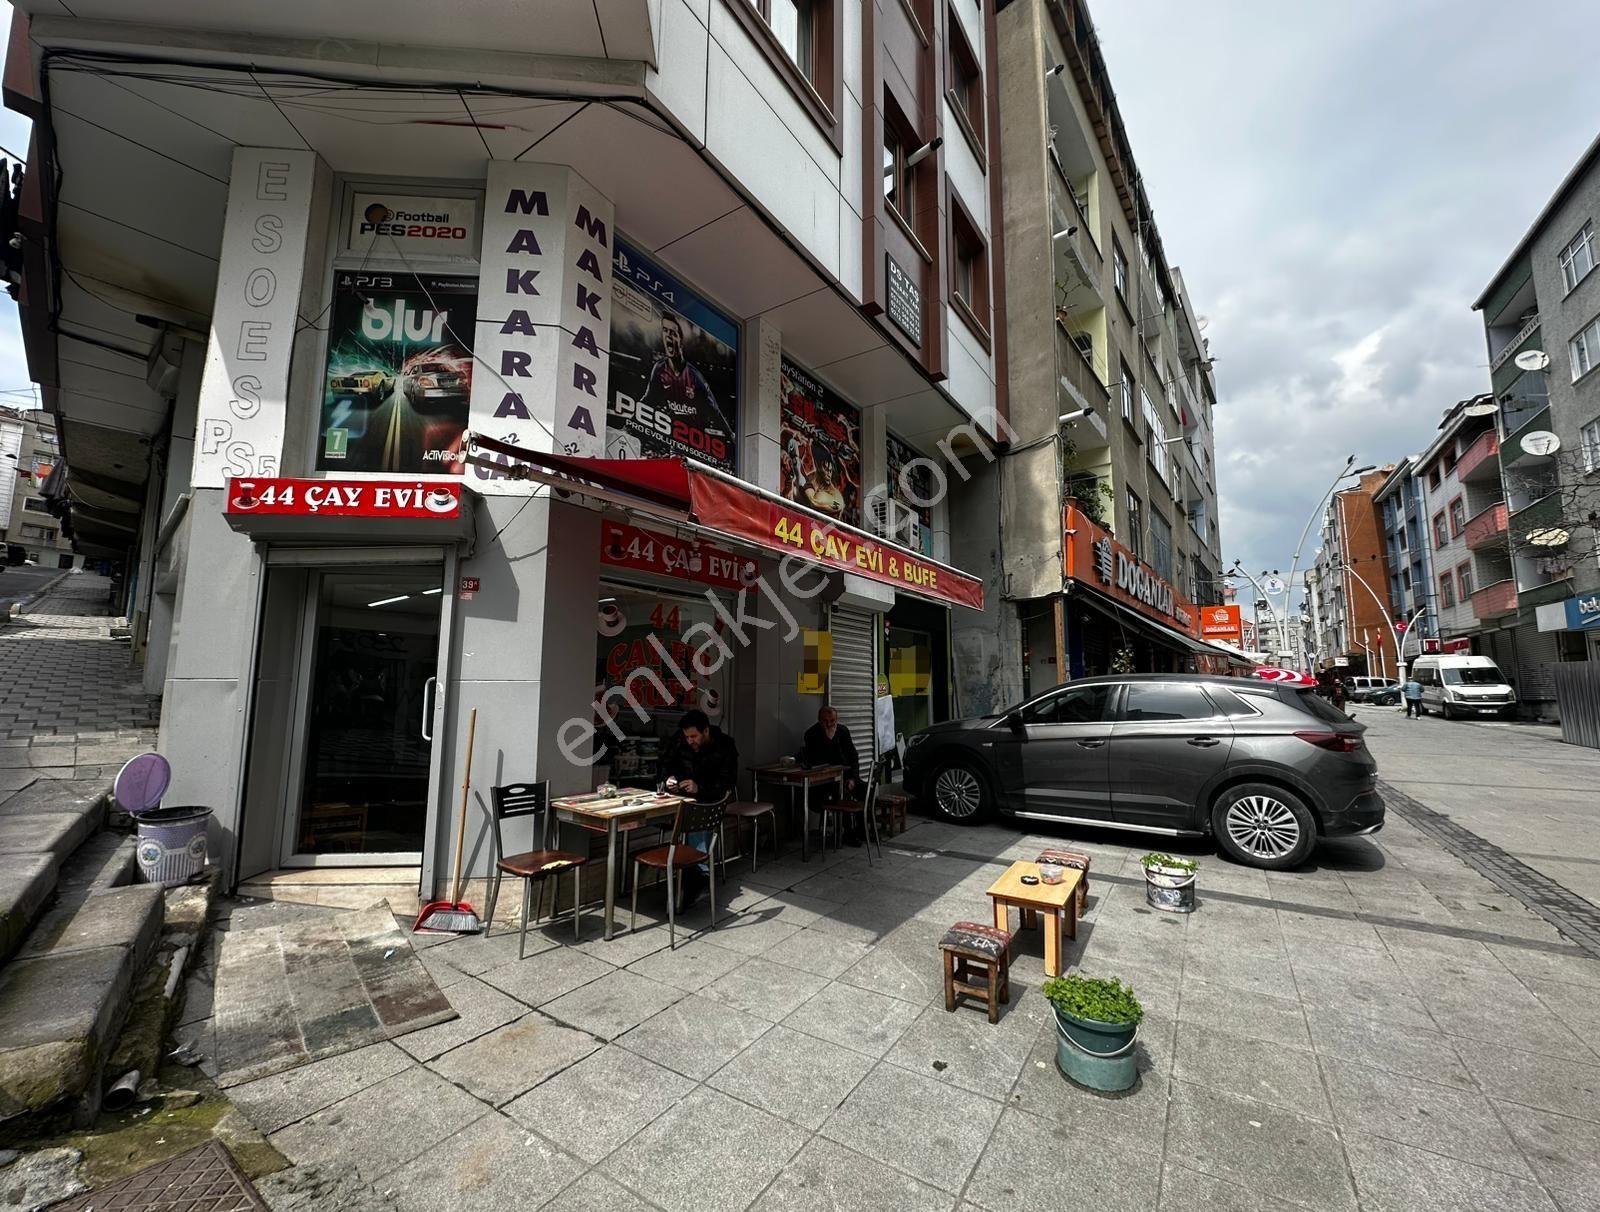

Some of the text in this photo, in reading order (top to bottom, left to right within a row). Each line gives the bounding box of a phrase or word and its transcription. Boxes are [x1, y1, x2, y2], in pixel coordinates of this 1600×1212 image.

[356, 276, 393, 288] PS3
[636, 266, 675, 304] PS4
[361, 297, 448, 343] blur
[493, 188, 550, 420] MAKARA
[566, 204, 608, 438] MAKARA
[781, 363, 816, 392] ayStation
[332, 431, 342, 450] 7
[626, 418, 718, 466] PRO EVOLUTION SOCCER
[259, 482, 424, 512] 44 ÇAY EVİ
[626, 536, 740, 581] 44 ÇA EVİ
[774, 517, 938, 590] 44 ÇAY EVİ & BÜFE
[650, 602, 681, 631] 44
